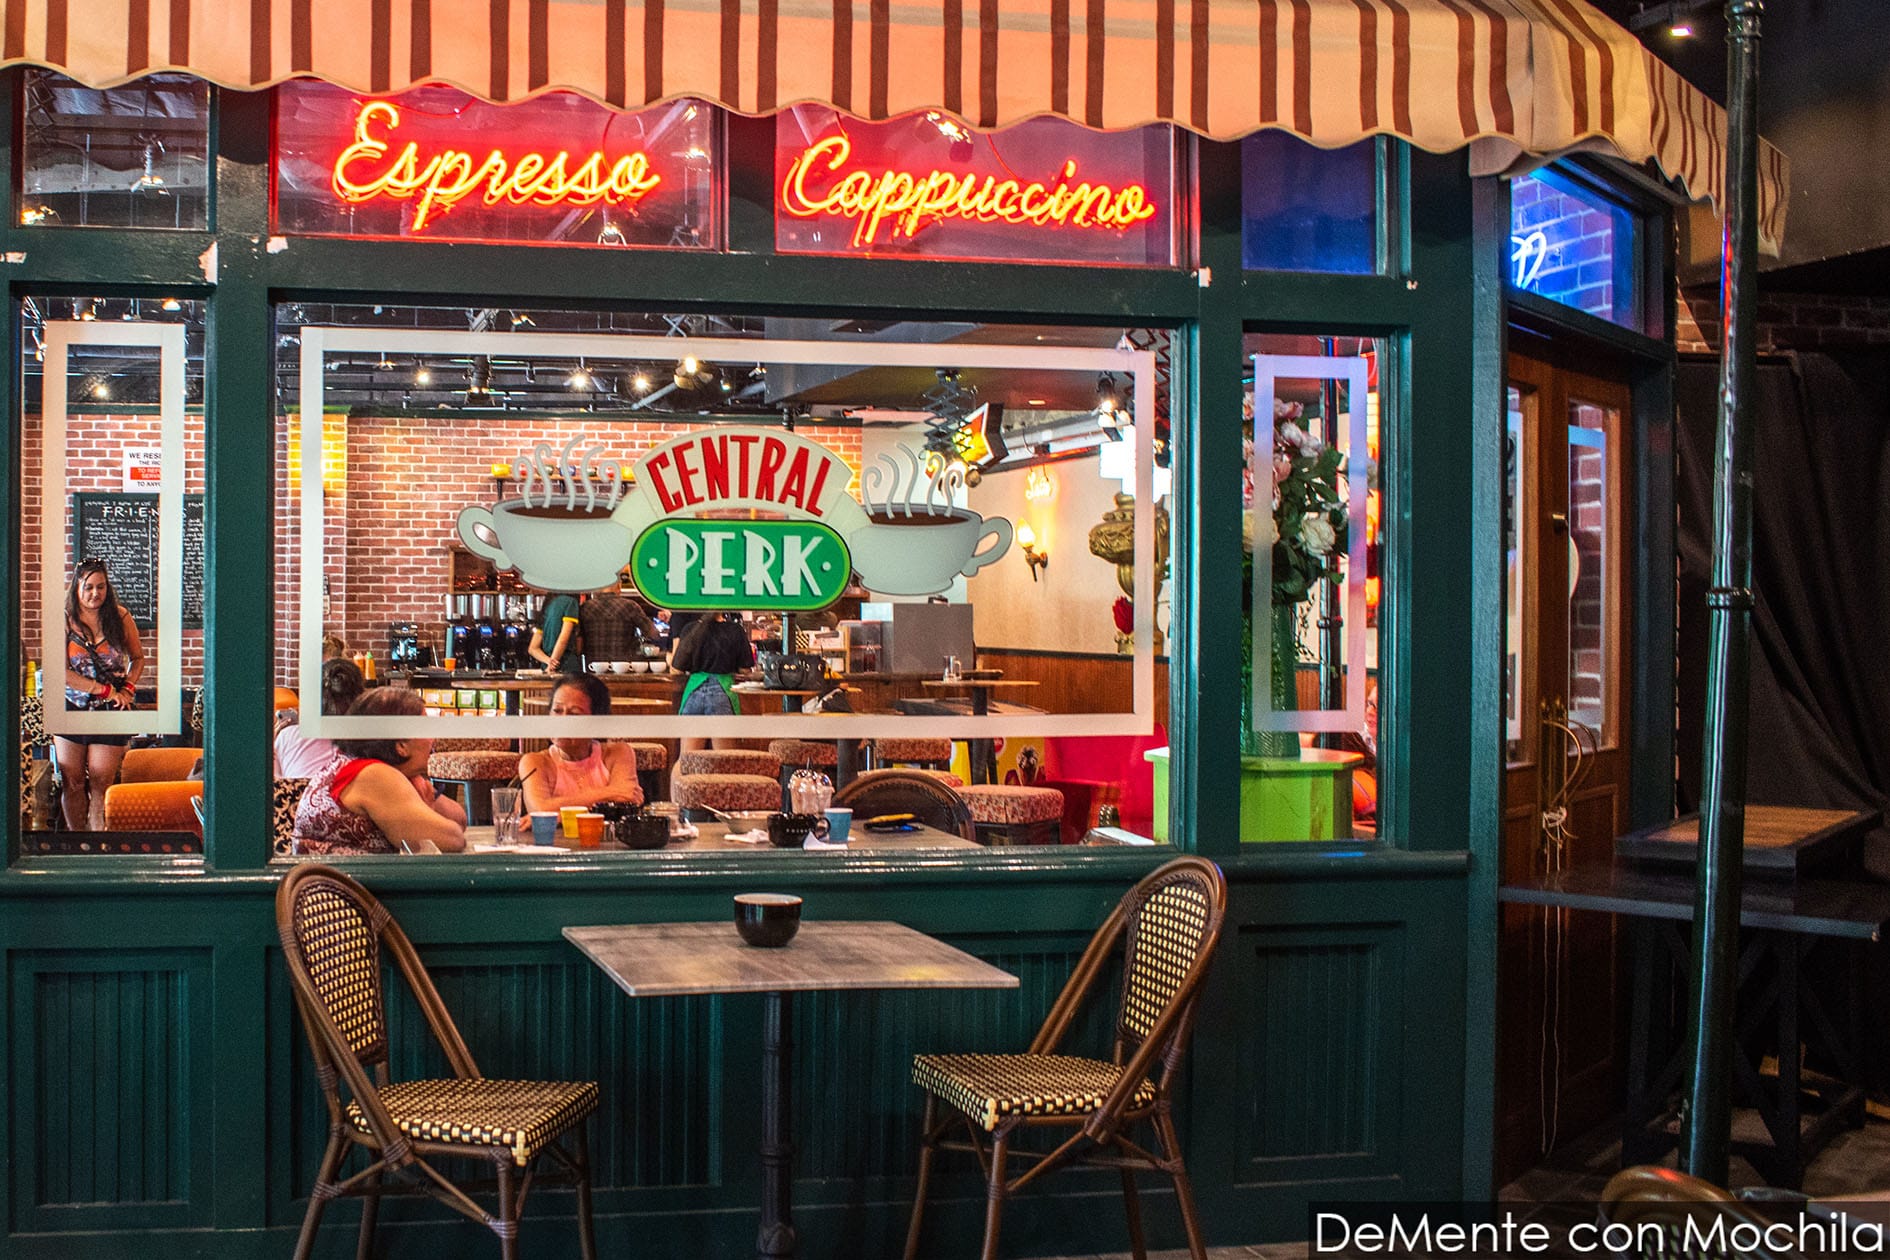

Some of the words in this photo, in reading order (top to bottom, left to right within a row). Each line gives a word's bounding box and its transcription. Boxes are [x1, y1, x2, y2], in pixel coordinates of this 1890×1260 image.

[333, 101, 661, 231] Espresso
[783, 136, 1155, 246] Cappuccino
[646, 434, 832, 518] CENTRAL
[665, 527, 824, 597] PERK
